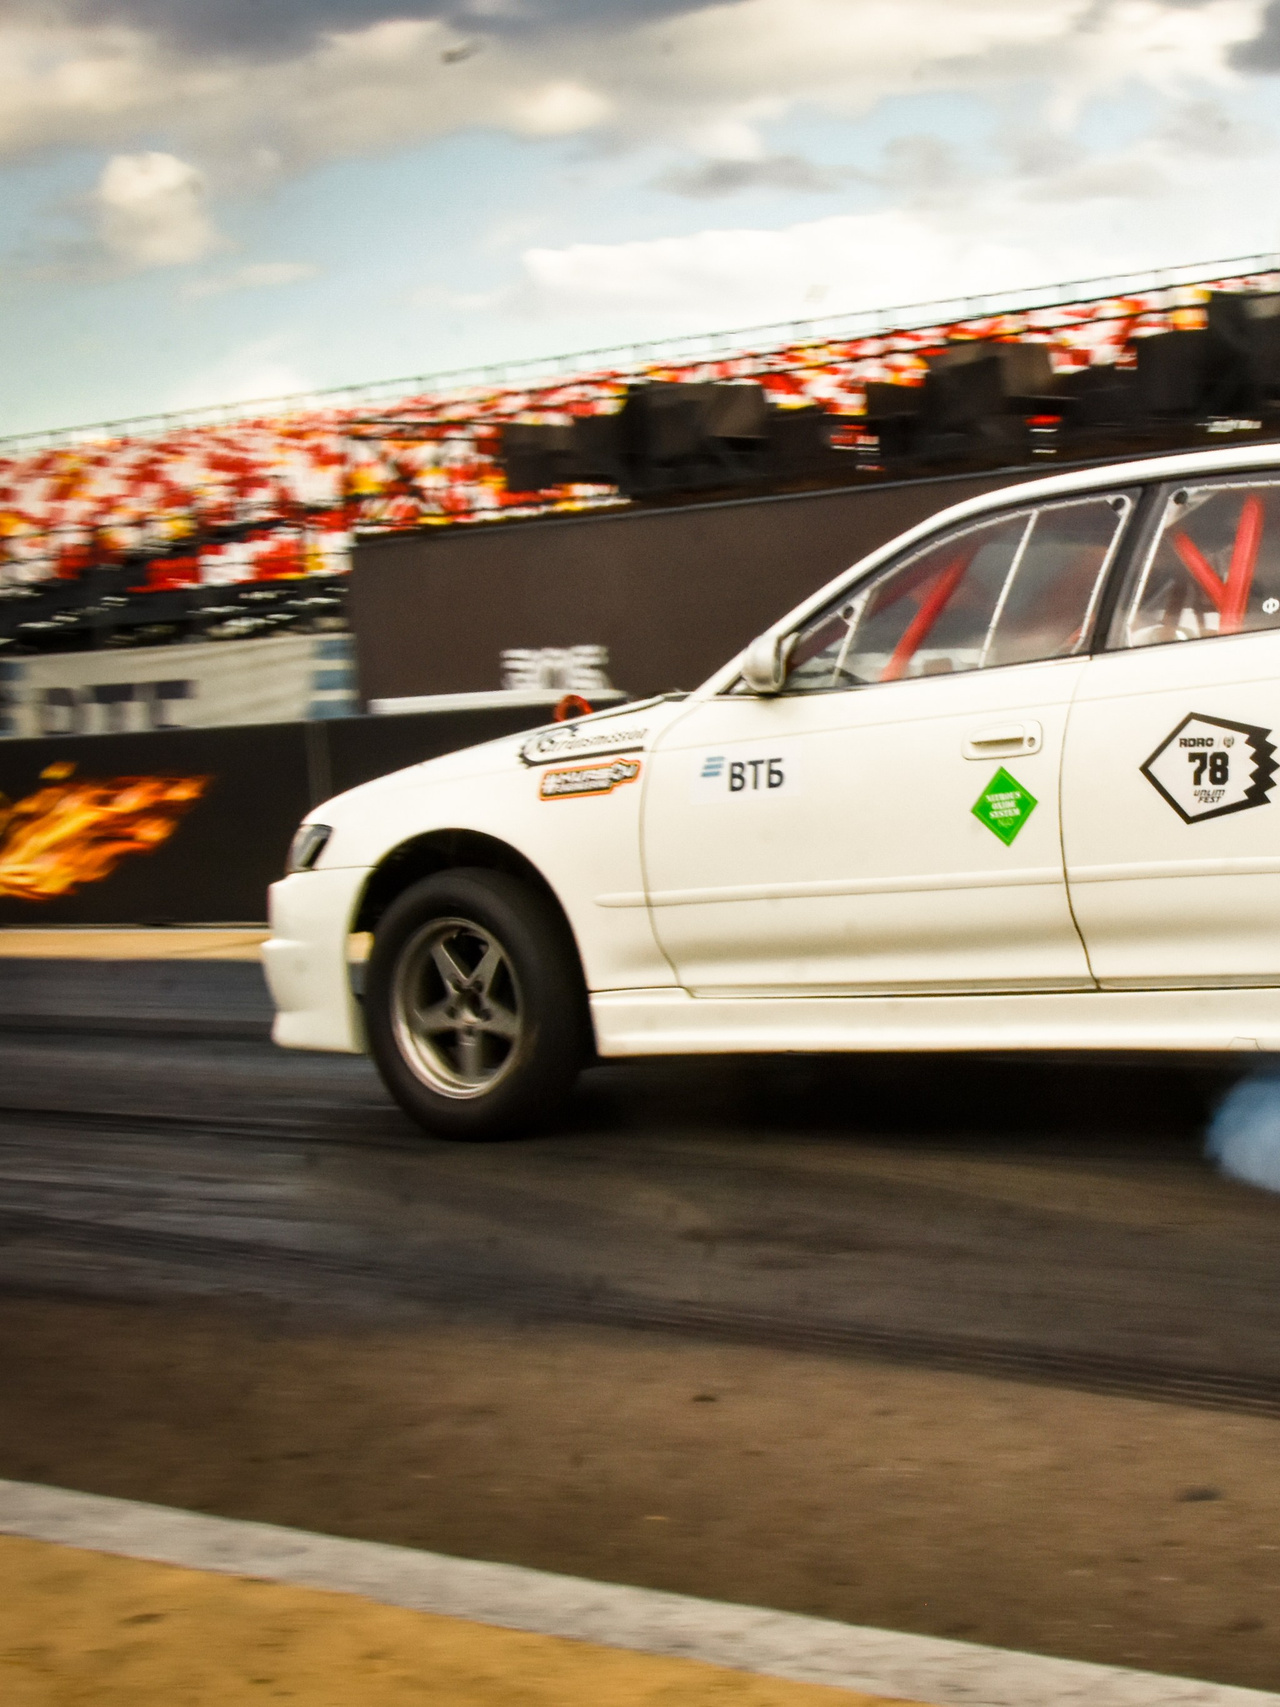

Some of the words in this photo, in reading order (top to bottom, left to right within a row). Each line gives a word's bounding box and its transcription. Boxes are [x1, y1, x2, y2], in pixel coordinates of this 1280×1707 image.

[1179, 737, 1214, 747] RDRC
[729, 757, 784, 792] ВТБ
[1188, 751, 1229, 785] 78
